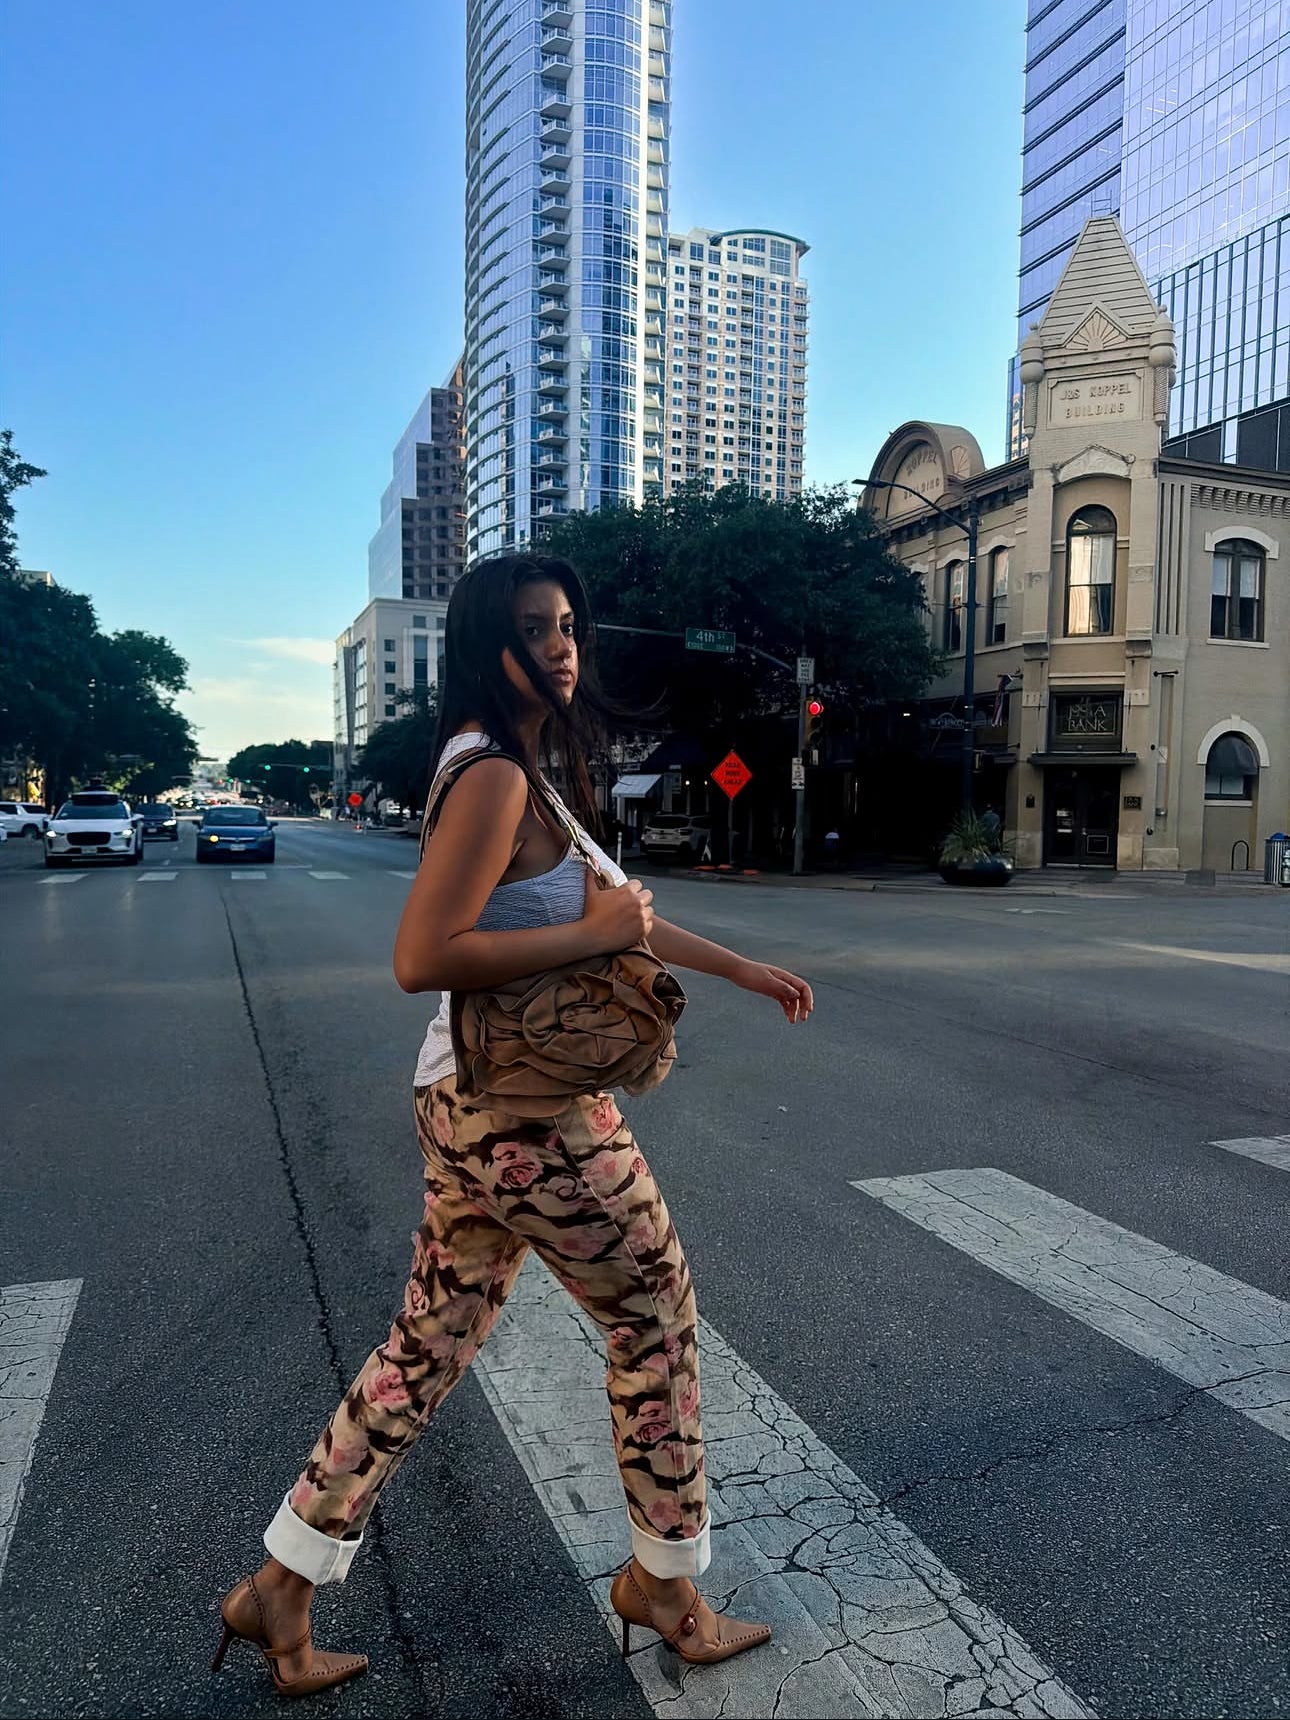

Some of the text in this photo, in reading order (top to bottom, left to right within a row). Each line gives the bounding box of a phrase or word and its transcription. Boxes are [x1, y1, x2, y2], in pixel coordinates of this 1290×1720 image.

[1089, 382, 1132, 399] KOPPEL
[1065, 402, 1125, 420] BUILDING
[696, 630, 715, 643] 4th
